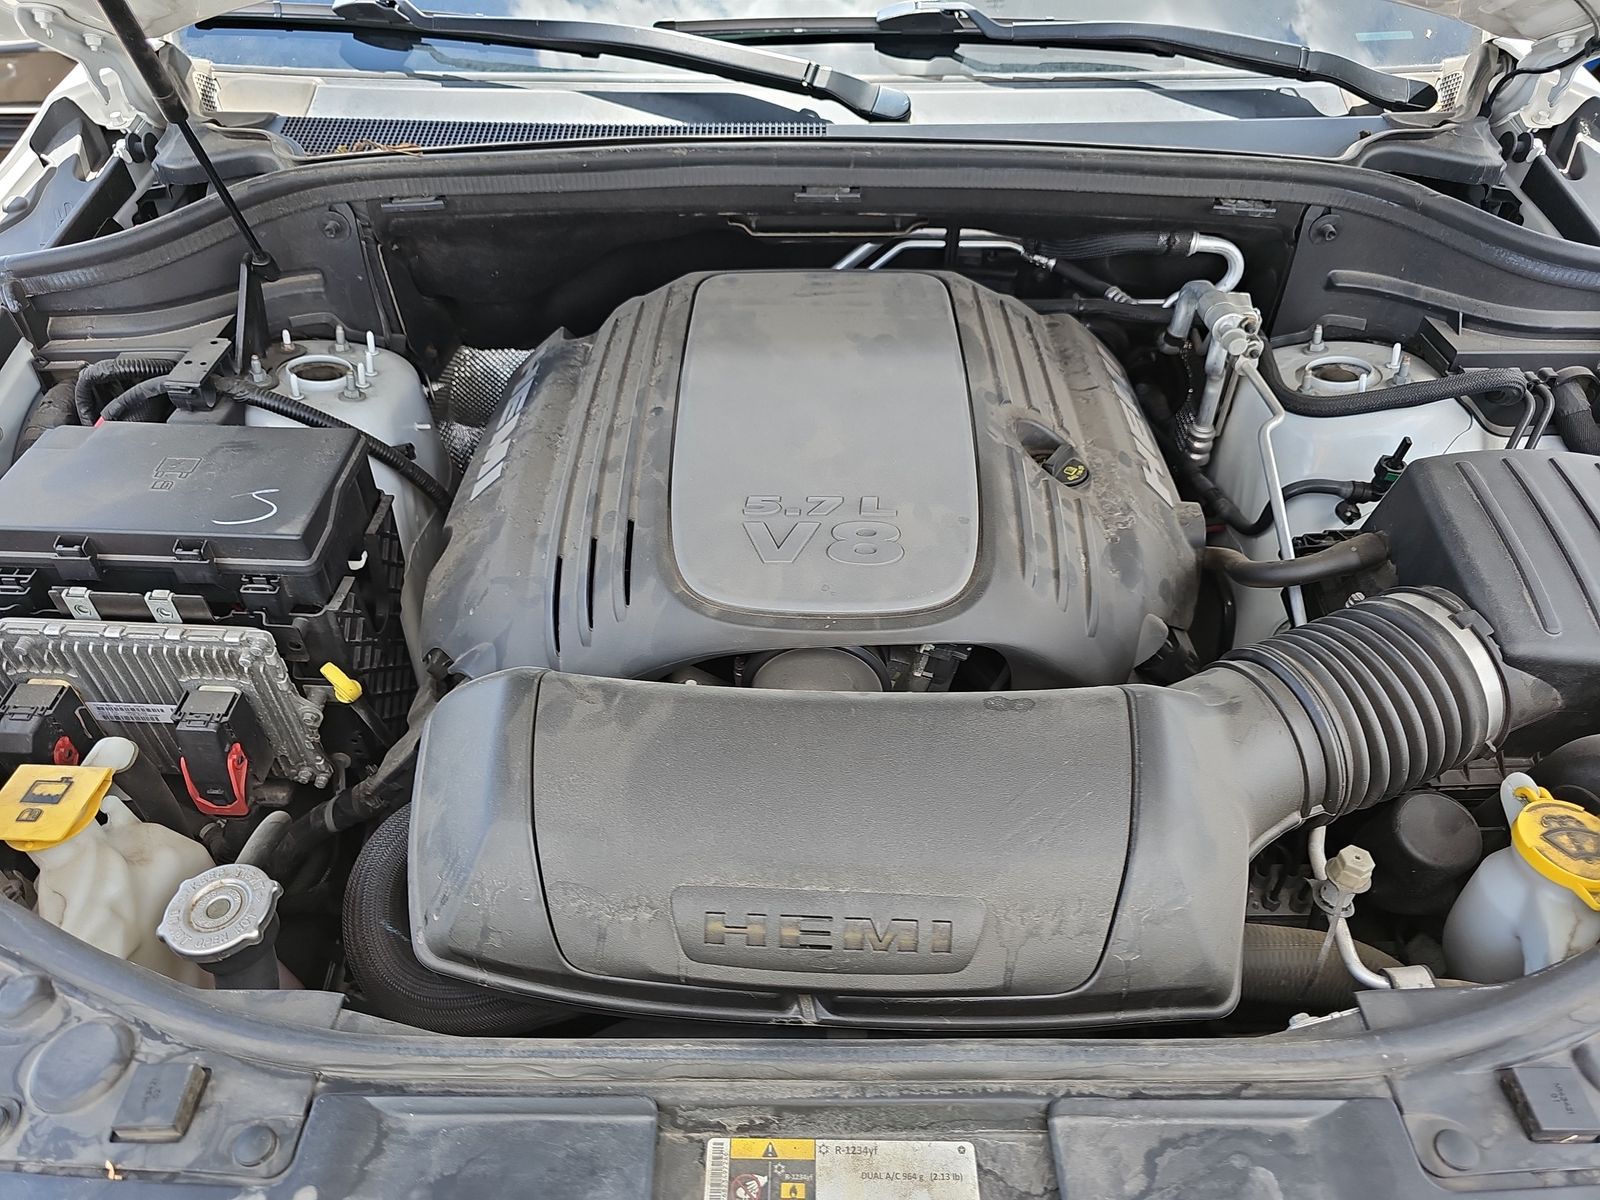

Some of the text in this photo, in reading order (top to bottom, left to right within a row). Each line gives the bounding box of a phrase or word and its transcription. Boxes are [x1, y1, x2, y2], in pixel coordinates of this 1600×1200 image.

[742, 494, 899, 517] 5.7 L
[742, 520, 906, 566] V8
[704, 911, 953, 953] HEMI
[835, 1144, 878, 1157] R-1234yf
[861, 1172, 883, 1180] DUAL
[885, 1172, 901, 1181] A/C
[930, 1172, 951, 1182] (2.13
[952, 1172, 963, 1182] lb)
